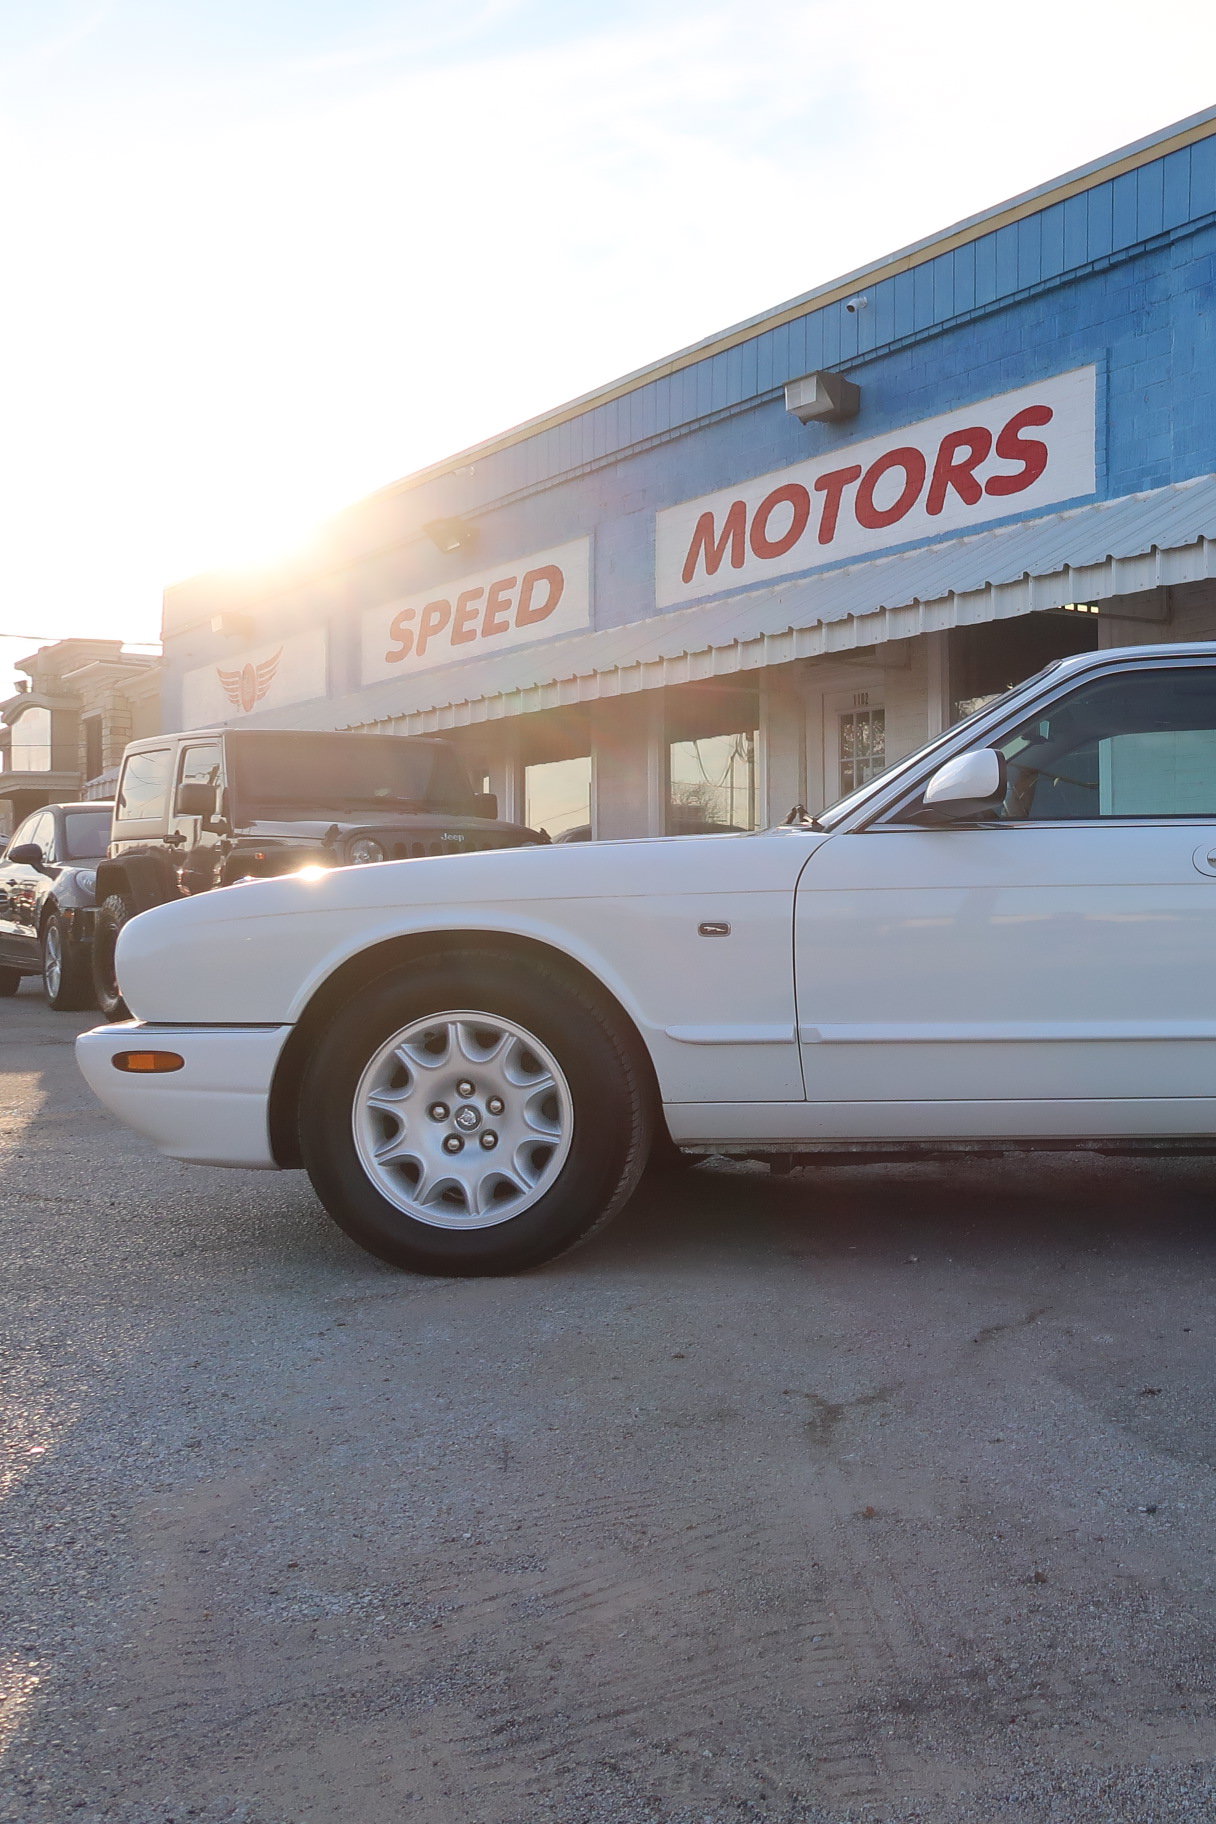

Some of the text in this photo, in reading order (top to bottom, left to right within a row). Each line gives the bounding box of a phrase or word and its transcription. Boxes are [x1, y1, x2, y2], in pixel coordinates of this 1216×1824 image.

[682, 404, 1054, 584] MOTORS
[384, 564, 565, 664] SPEED
[440, 832, 465, 842] Jeep
